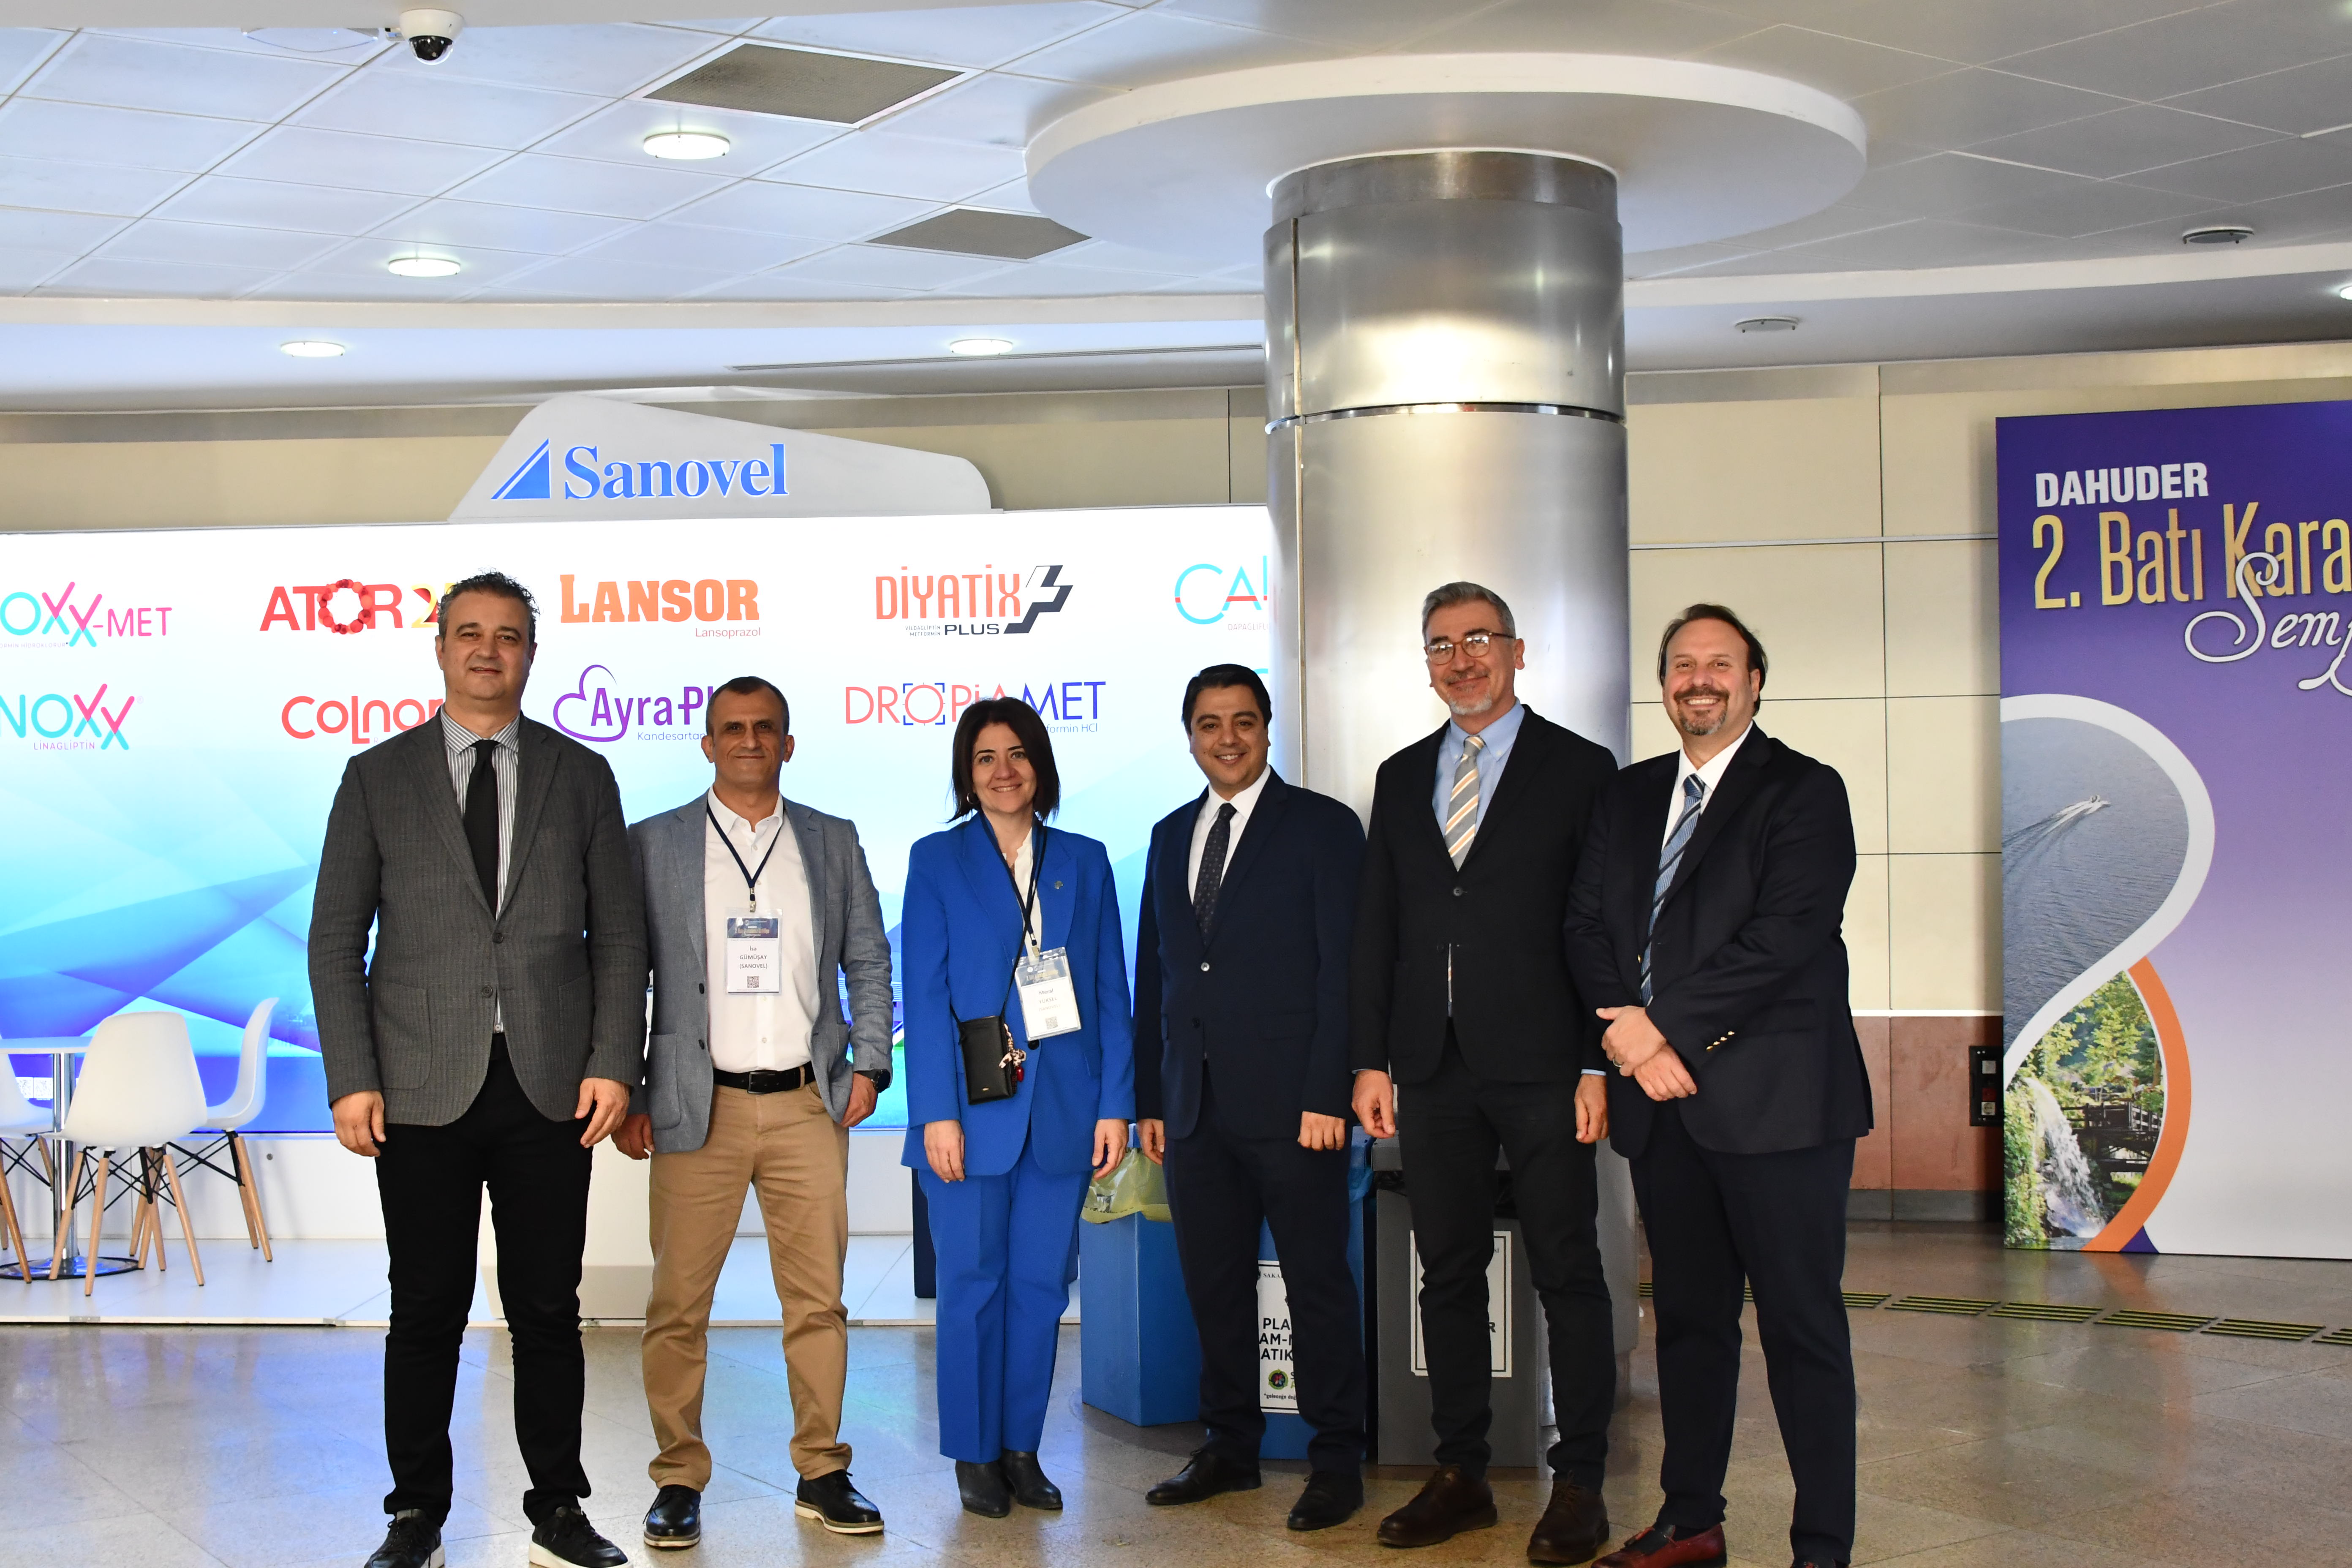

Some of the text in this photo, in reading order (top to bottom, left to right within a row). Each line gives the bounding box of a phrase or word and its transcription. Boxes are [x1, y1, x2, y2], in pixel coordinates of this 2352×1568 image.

[565, 444, 789, 500] Sanovel
[2036, 463, 2209, 507] DAHUDER
[2032, 514, 2080, 609] 2.
[2099, 508, 2204, 605] Batı
[259, 579, 403, 635] ATOR
[560, 574, 760, 623] LANSOR
[876, 564, 1020, 619] DİYATİX
[695, 627, 761, 639] Lansoprazol
[945, 623, 999, 635] PLUS
[34, 739, 95, 751] LİNAGLİPTİN
[638, 732, 705, 741] Kandesartan
